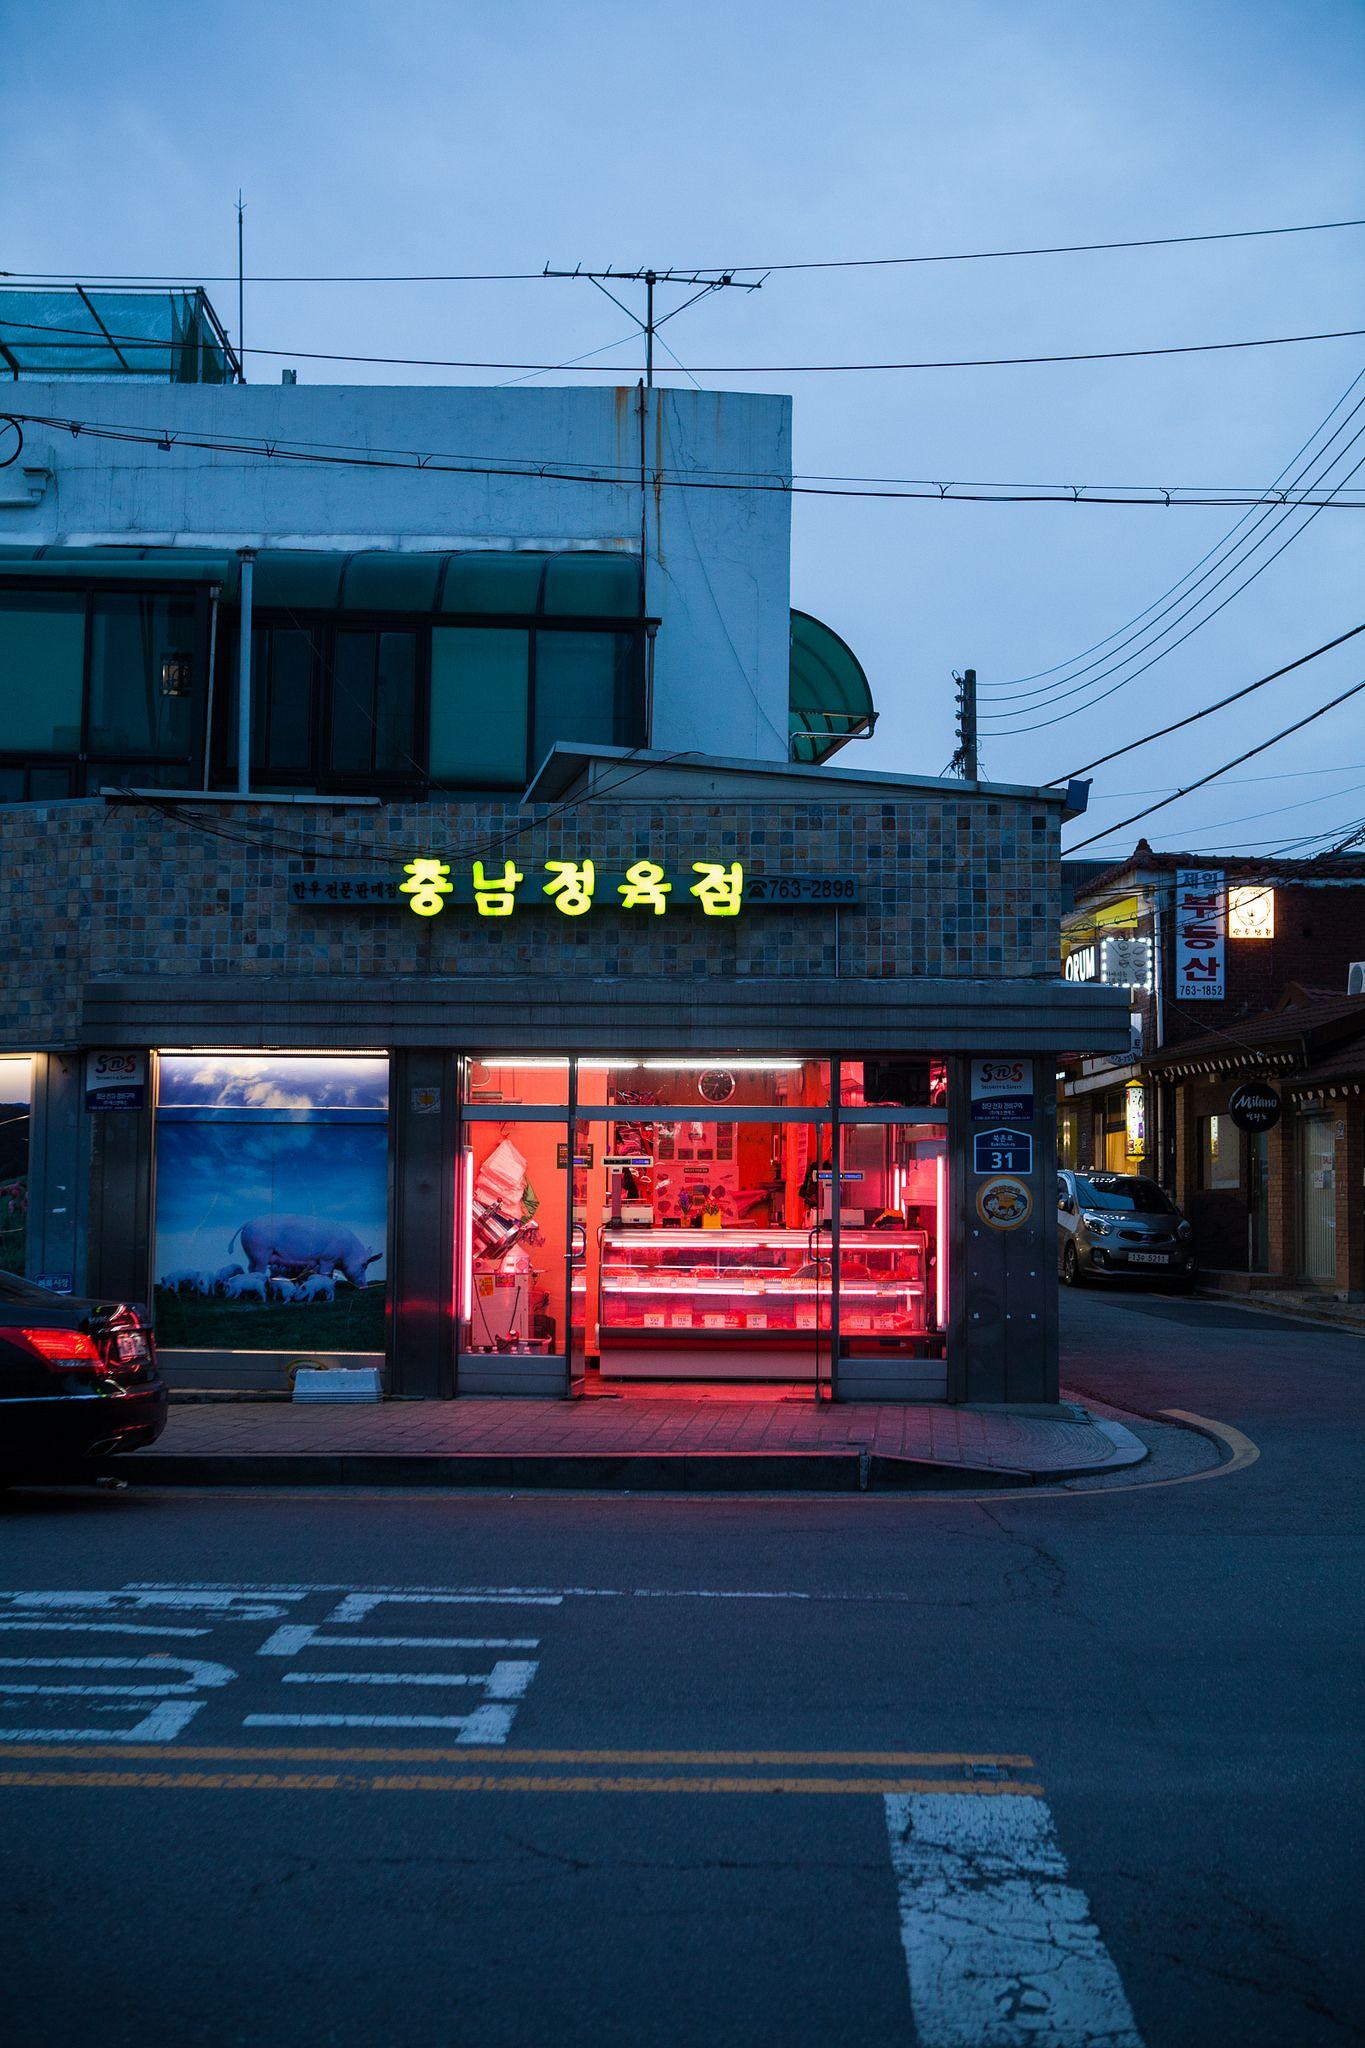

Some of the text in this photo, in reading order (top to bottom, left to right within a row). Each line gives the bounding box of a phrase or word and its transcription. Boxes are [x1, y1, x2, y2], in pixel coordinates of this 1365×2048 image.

[398, 858, 746, 917] 충남정육점
[768, 880, 854, 898] 763-2898
[1184, 872, 1218, 889] 제일
[1182, 893, 1220, 982] 부동산
[1180, 985, 1223, 996] 763-1852
[1234, 1094, 1277, 1110] Milano
[991, 1152, 1014, 1169] 31
